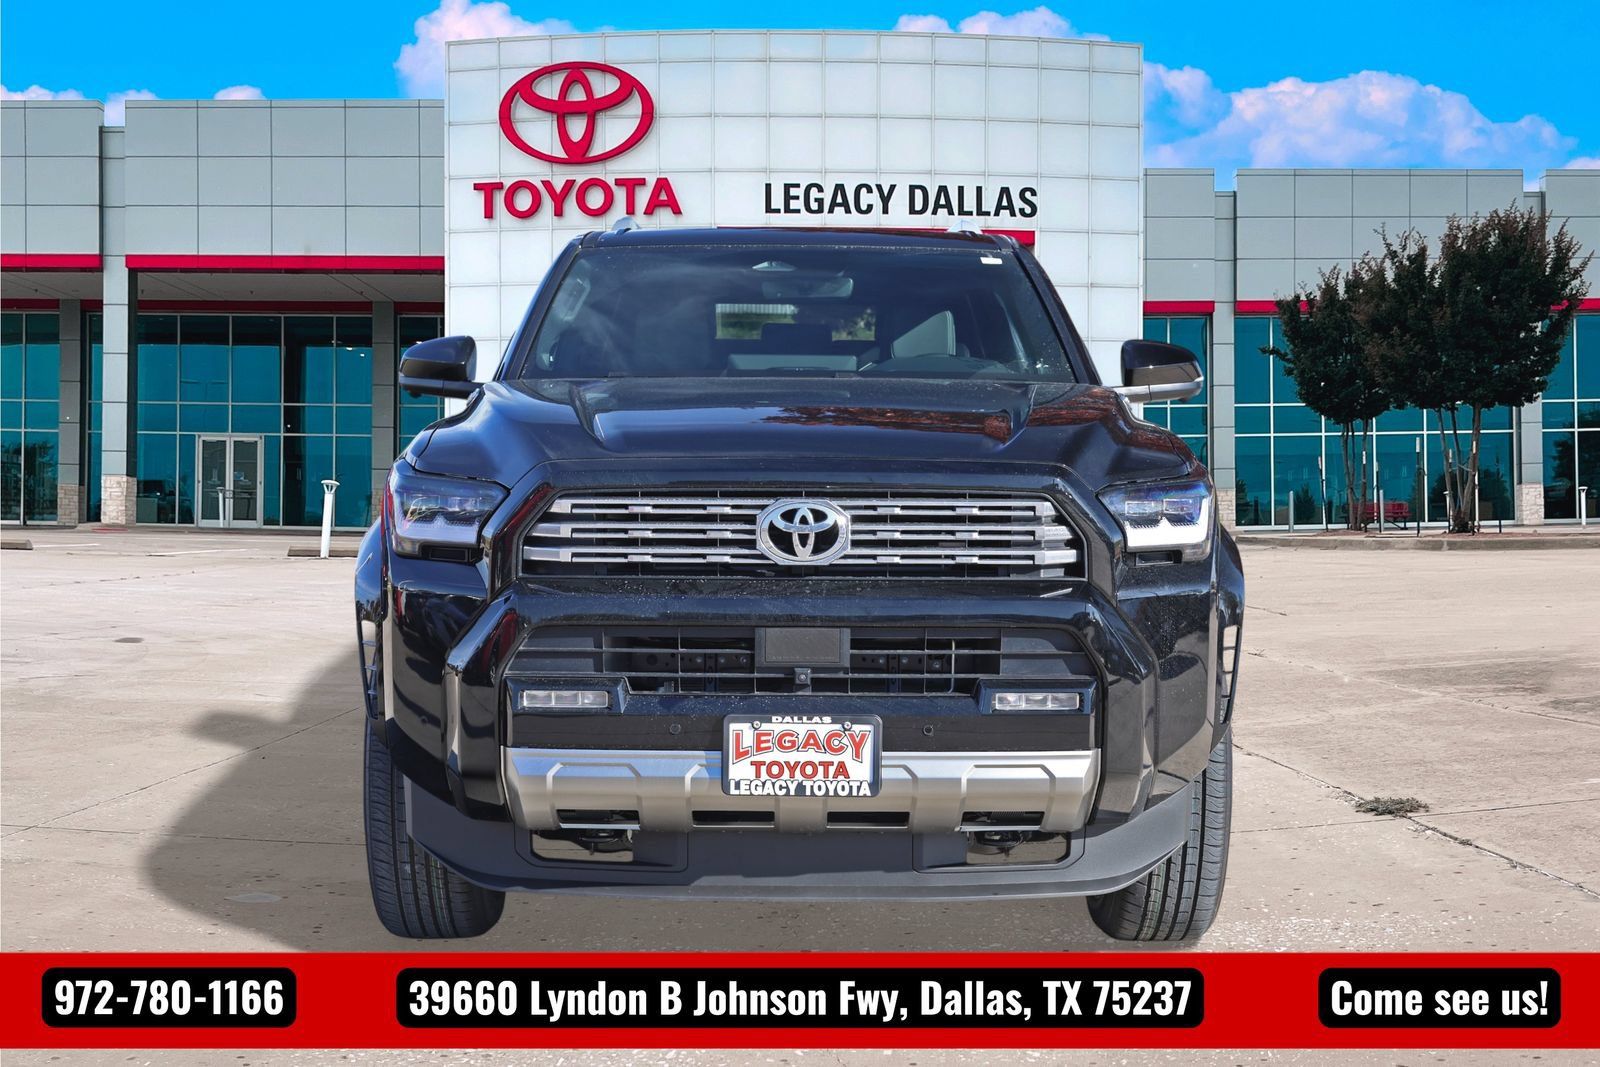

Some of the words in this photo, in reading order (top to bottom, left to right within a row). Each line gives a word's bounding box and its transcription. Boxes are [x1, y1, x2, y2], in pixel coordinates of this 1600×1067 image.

[474, 177, 681, 219] TOYOTA
[765, 182, 897, 215] LEGACY
[908, 184, 1038, 218] DALLAS
[771, 715, 833, 724] DALLAS
[733, 729, 871, 765] LEGACY
[750, 760, 850, 779] TOYOTA
[729, 779, 799, 796] LEGACY
[803, 780, 872, 797] TOYOTA
